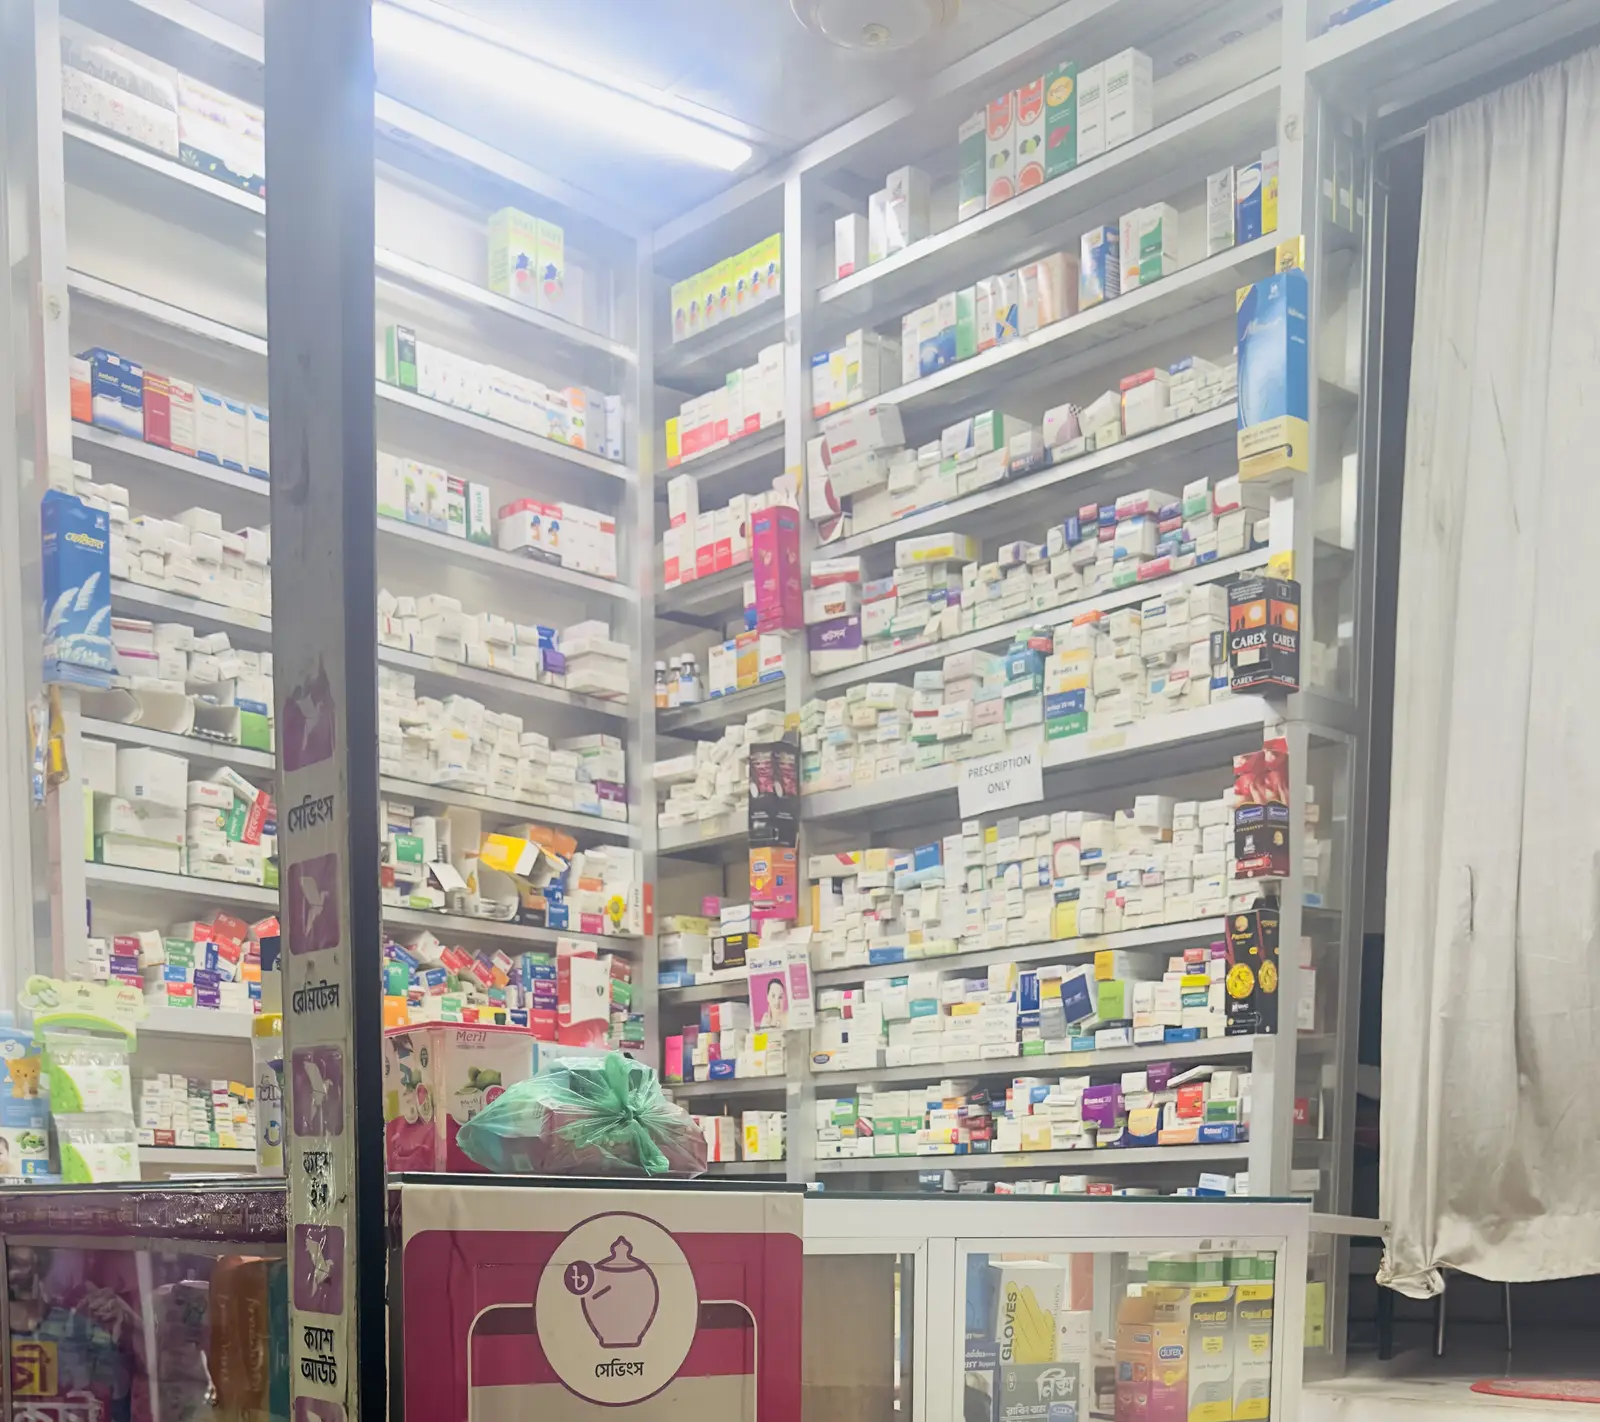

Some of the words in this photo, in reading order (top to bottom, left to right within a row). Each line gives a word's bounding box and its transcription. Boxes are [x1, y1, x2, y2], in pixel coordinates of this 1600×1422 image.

[1232, 629, 1267, 650] CAREX
[1272, 632, 1296, 648] CAREX
[968, 755, 1032, 778] PRESCRIPTION
[987, 780, 1011, 794] ONLY
[456, 1030, 487, 1043] Meril
[1001, 1291, 1018, 1361] GLOVES
[303, 1324, 334, 1355] ক্যাশ
[1159, 1347, 1184, 1359] durex
[300, 1354, 338, 1386] আউট
[594, 1357, 644, 1378] সেভিংস
